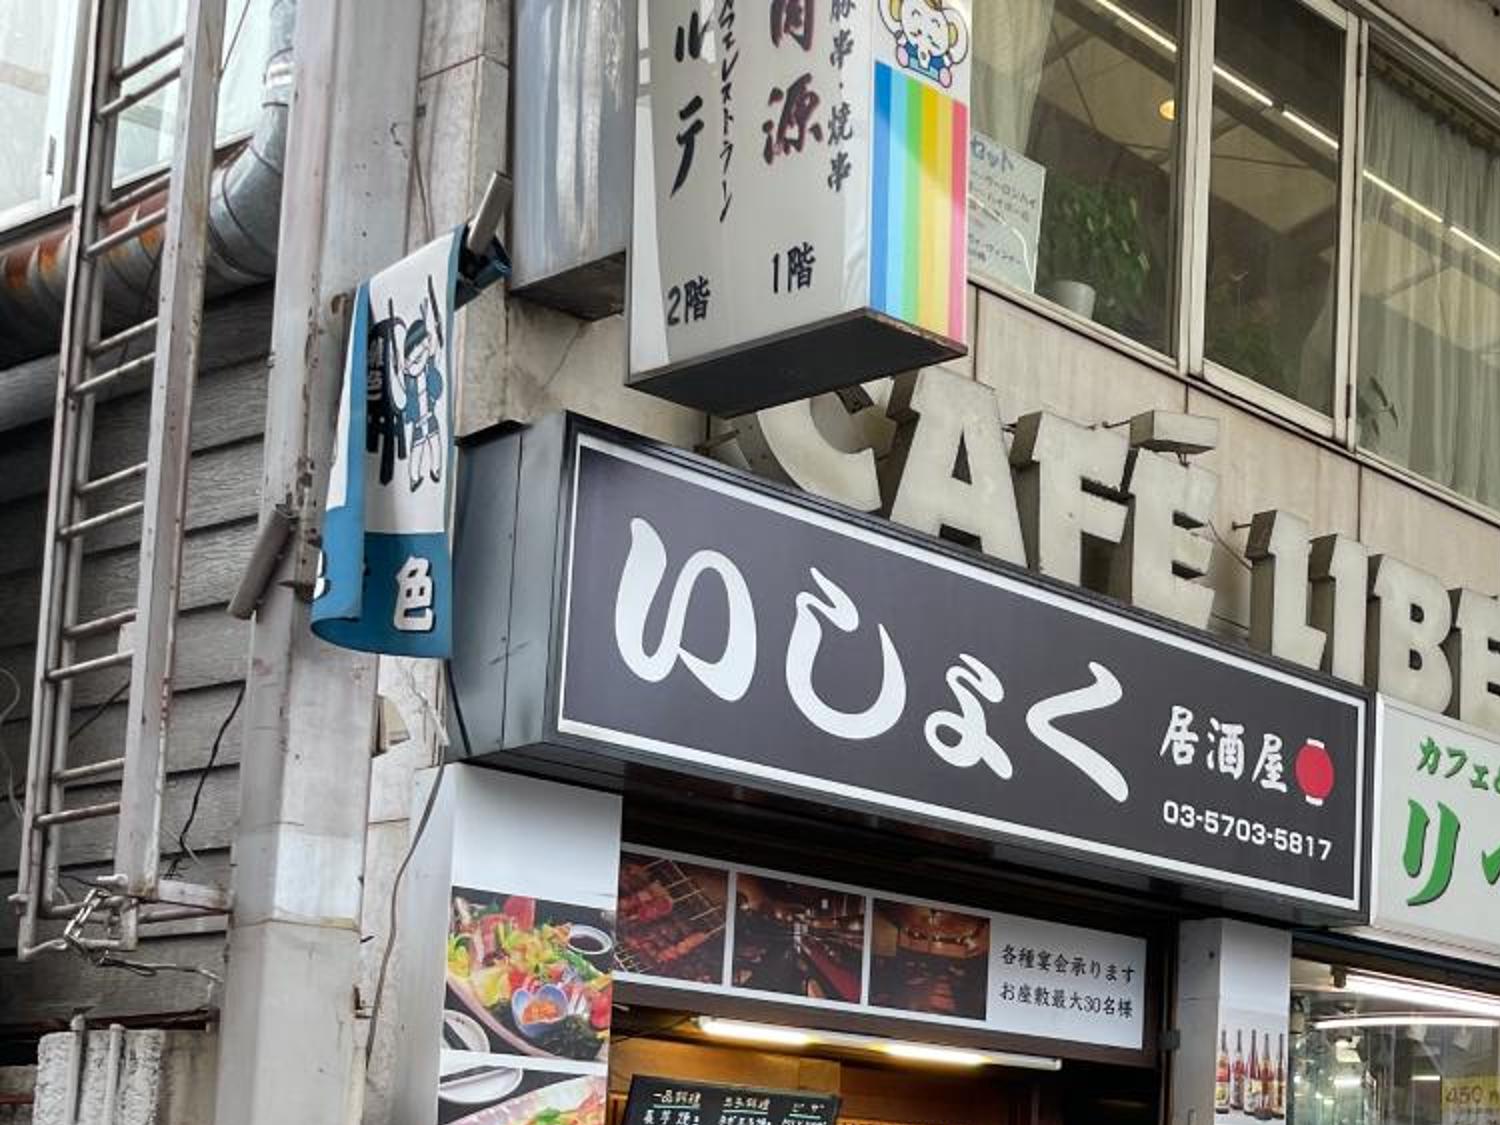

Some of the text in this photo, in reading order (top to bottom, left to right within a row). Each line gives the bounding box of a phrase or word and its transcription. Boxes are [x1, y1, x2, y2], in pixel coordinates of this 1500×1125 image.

[772, 242, 815, 294] 1階
[667, 277, 711, 326] 2階
[1160, 705, 1288, 793] 居酒屋
[1163, 800, 1332, 861] 03-5703-5817
[1002, 944, 1135, 984] 各種宴会承ります
